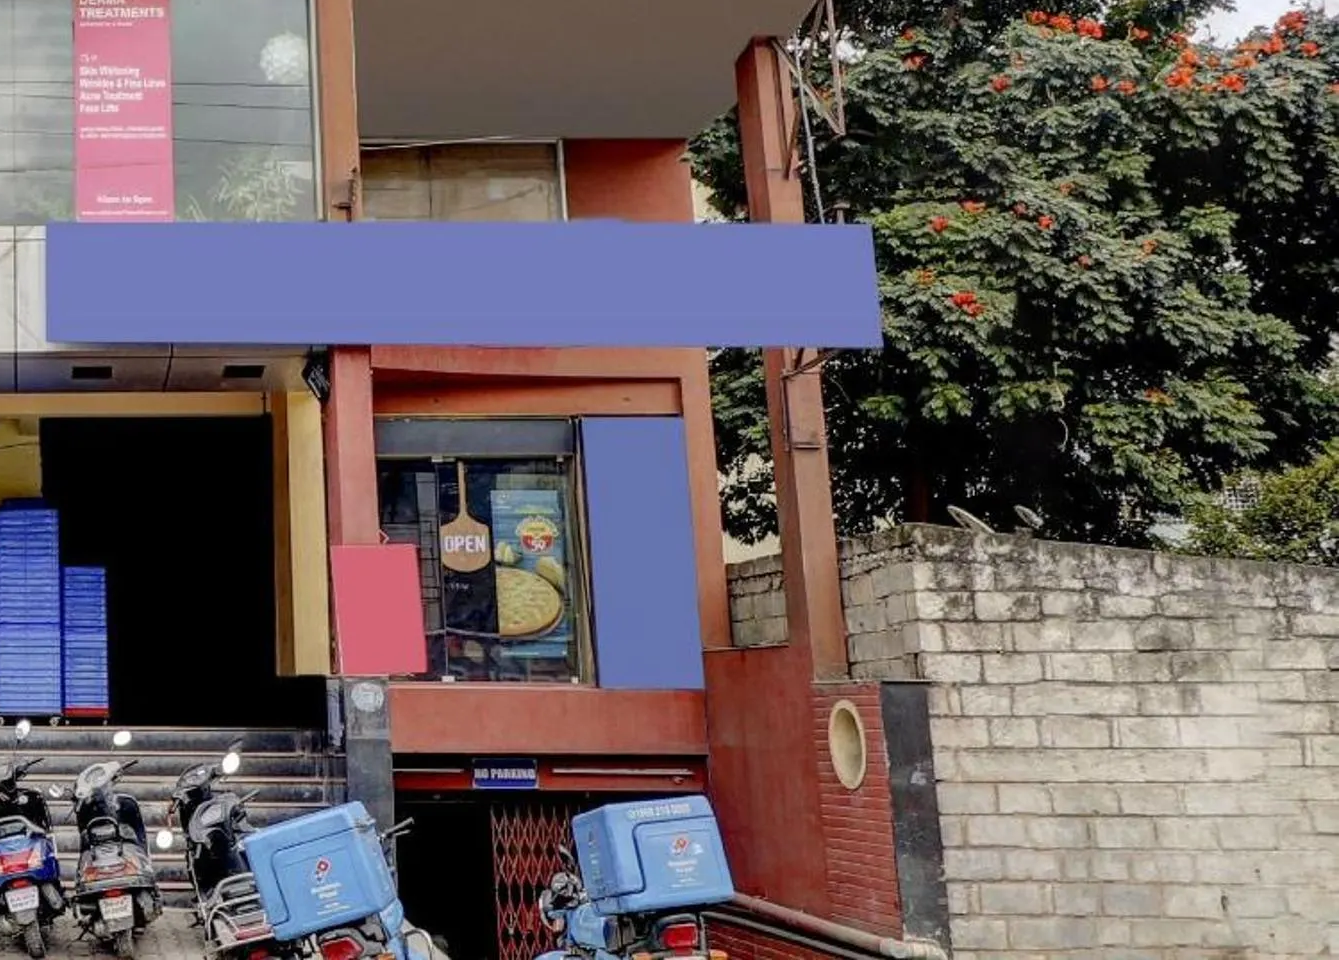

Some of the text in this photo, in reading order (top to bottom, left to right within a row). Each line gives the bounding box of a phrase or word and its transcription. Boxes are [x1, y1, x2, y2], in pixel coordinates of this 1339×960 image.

[79, 7, 164, 18] TREATMENTS
[444, 535, 486, 553] OPEN
[474, 768, 536, 779] NO PARKING
